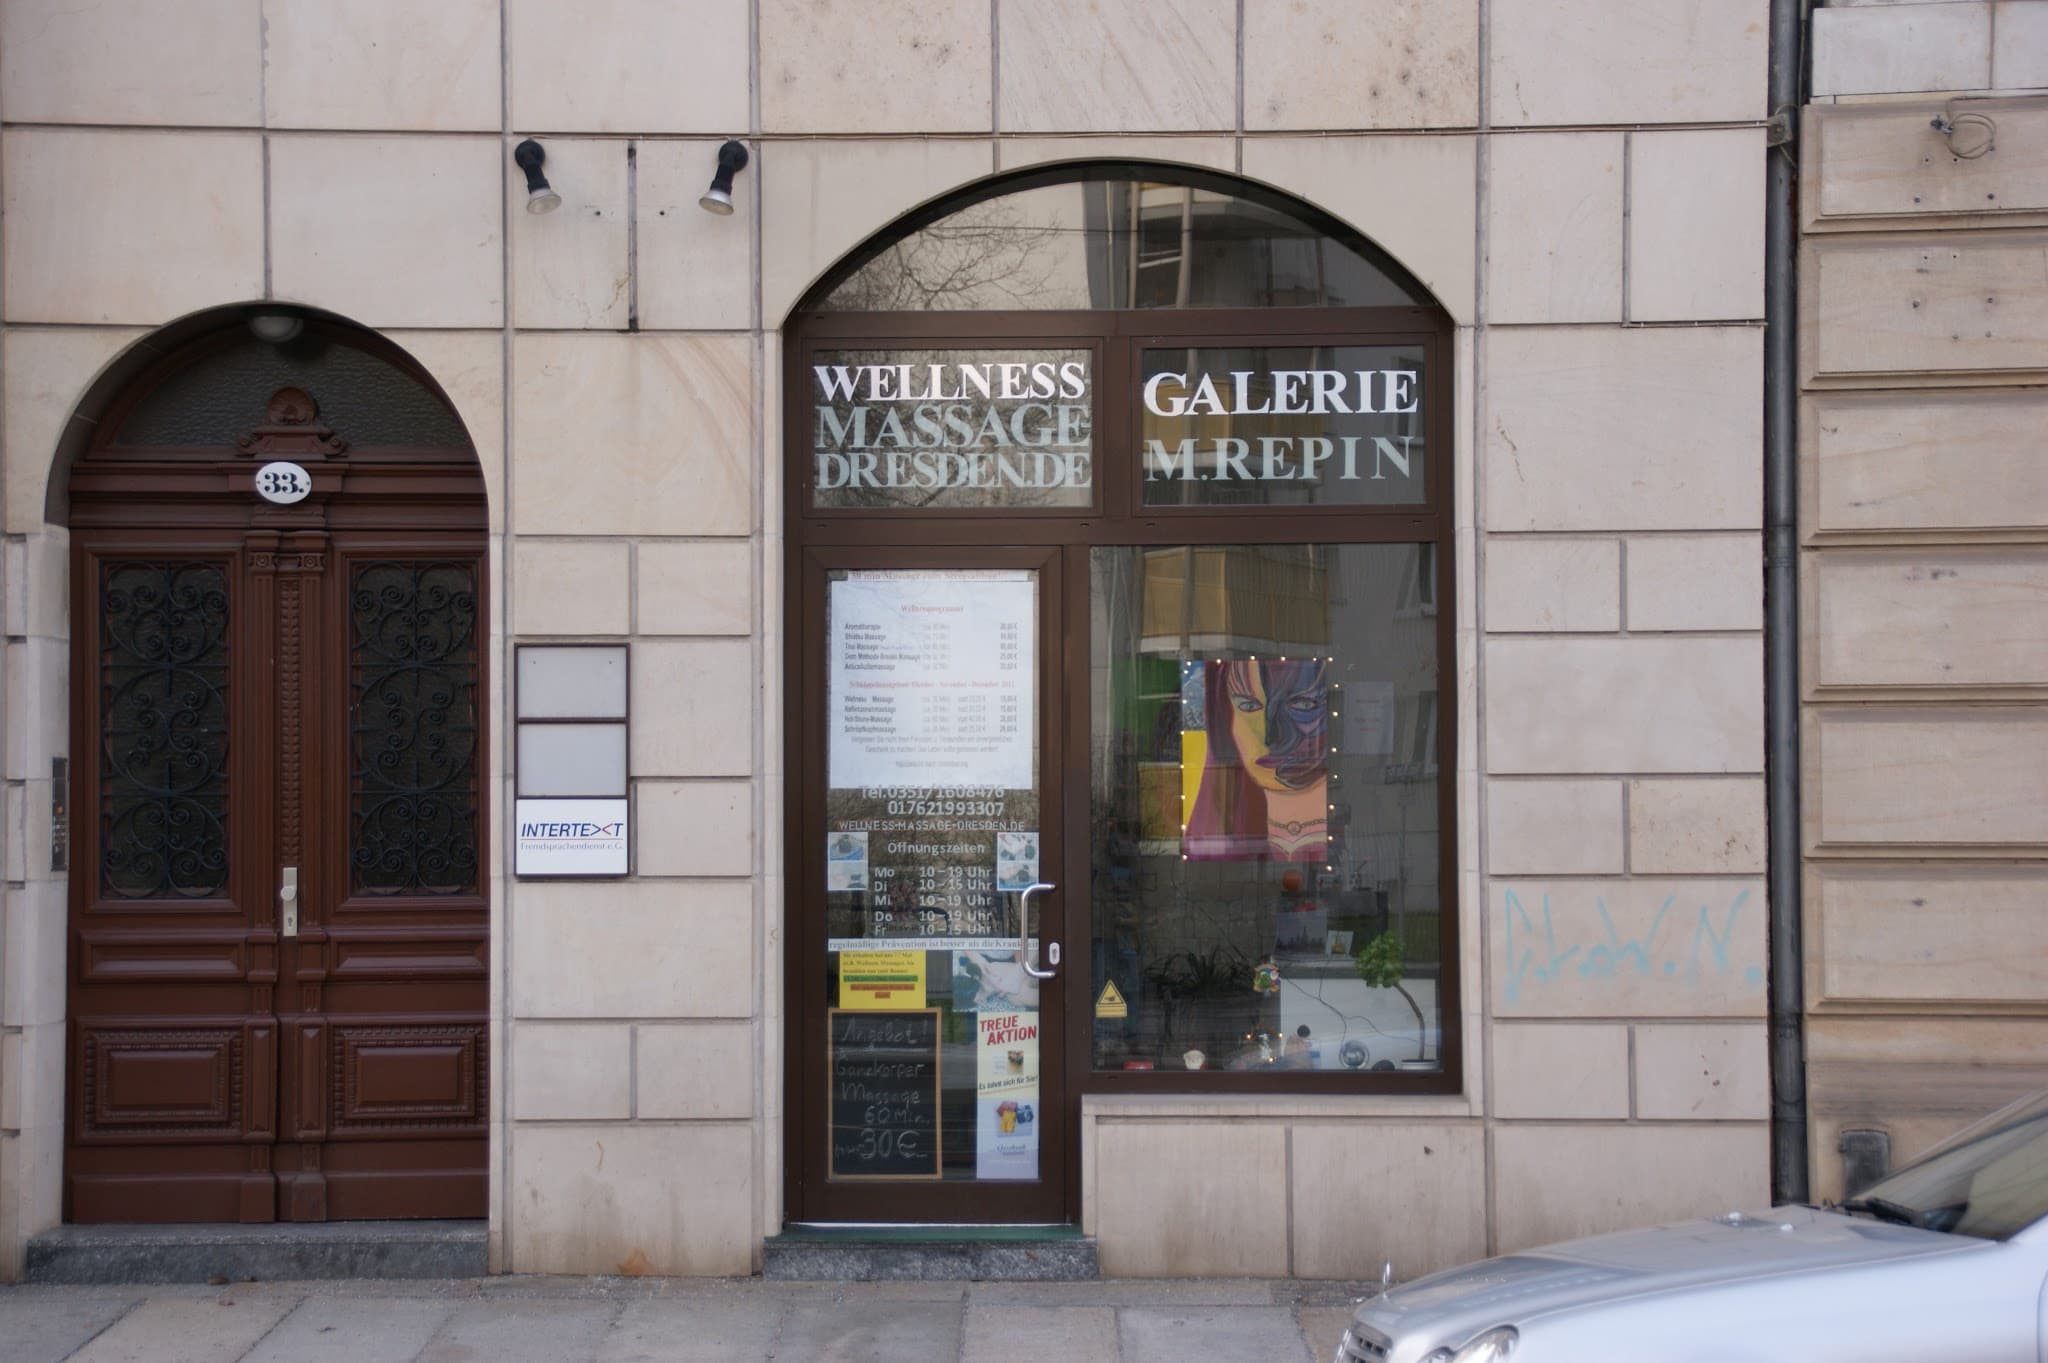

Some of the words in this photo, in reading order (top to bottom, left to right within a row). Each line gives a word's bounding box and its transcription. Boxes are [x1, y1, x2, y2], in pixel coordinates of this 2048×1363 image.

[813, 362, 1086, 401] WELLNESS
[1143, 370, 1418, 416] GALERIE
[815, 403, 1091, 448] MASSAGE
[888, 800, 1004, 816] 017621993307
[887, 841, 985, 855] Öffnungszeiten
[874, 867, 895, 877] Mo
[920, 866, 935, 877] 10
[967, 866, 992, 877] Uhr
[874, 881, 887, 891] Di
[920, 879, 935, 890] 10
[967, 879, 992, 890] Uhr
[875, 895, 892, 905] Mi
[920, 895, 935, 905] 10
[967, 895, 992, 905] Uhr
[875, 911, 893, 921] Do
[920, 910, 935, 921] 10
[967, 910, 992, 921] Uhr
[875, 925, 887, 936] Fr
[920, 925, 935, 935] 10
[967, 924, 991, 935] Uhr
[980, 1015, 1018, 1032] TREUE
[987, 1025, 1037, 1046] AKTION
